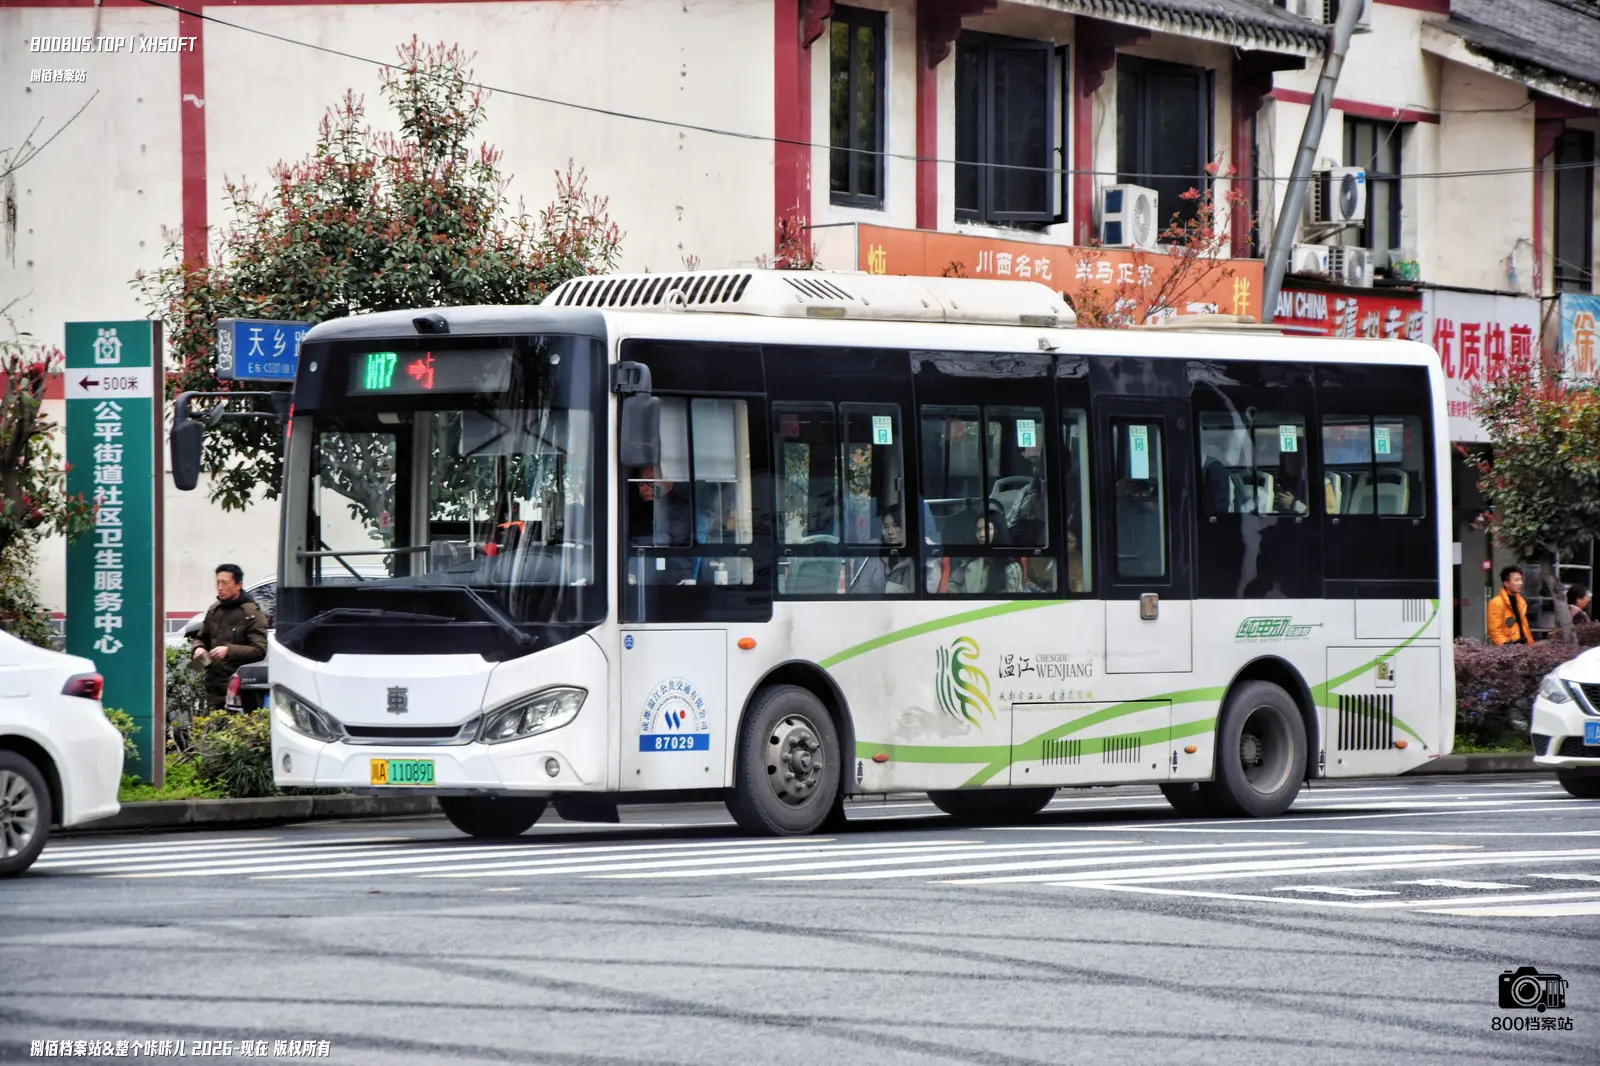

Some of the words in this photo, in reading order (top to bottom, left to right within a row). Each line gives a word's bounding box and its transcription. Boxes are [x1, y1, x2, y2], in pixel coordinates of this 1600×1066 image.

[976, 250, 1053, 281] 川西名吃
[1295, 292, 1328, 320] CHINA
[1433, 318, 1532, 383] 优质快剪
[103, 377, 138, 390] 500米
[93, 401, 124, 654] 公平街道社区卫生服务中心
[999, 653, 1034, 678] 温江
[1036, 653, 1070, 663] CHENGDU
[1036, 663, 1093, 681] WENJIANG
[655, 736, 694, 749] 87029
